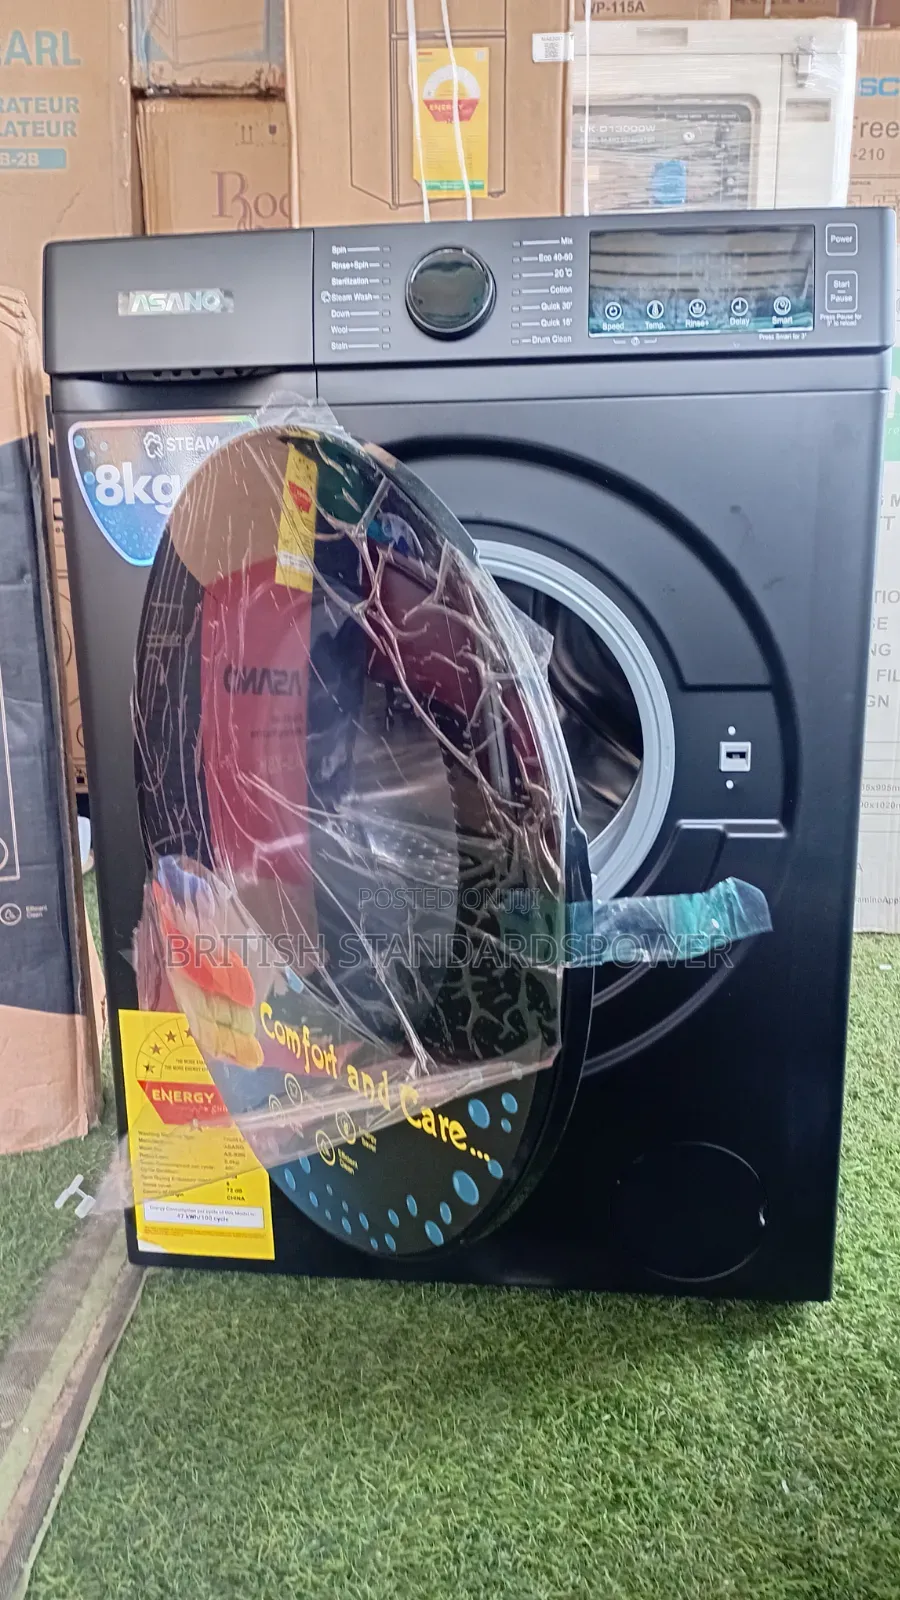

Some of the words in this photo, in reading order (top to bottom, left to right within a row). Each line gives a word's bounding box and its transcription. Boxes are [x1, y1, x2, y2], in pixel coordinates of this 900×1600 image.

[0, 29, 81, 66] ARL
[853, 116, 900, 138] ree
[560, 237, 573, 245] Mix
[830, 234, 853, 244] Power
[331, 246, 347, 255] Spin
[538, 254, 552, 263] Eco
[331, 277, 369, 287] Sterilization
[833, 280, 850, 289] Start
[550, 285, 573, 294] Cotton
[131, 290, 223, 312] ASANO
[331, 293, 353, 302] Steam
[353, 292, 373, 301] Wash
[830, 294, 853, 303] Pause
[541, 301, 561, 311] Quick
[540, 317, 561, 328] Quick
[729, 317, 750, 328] Delay
[772, 316, 793, 325] Smart
[330, 325, 348, 334] Wool
[602, 321, 625, 331] Speed
[645, 321, 666, 331] Temp.
[532, 335, 551, 344] Drum
[552, 334, 573, 343] Clean
[331, 341, 348, 351] Stain
[166, 435, 220, 451] STEAM
[95, 462, 181, 515] 8kg
[260, 1002, 337, 1079] Comfort
[347, 1064, 391, 1112] and
[151, 1086, 215, 1105] ENERGY
